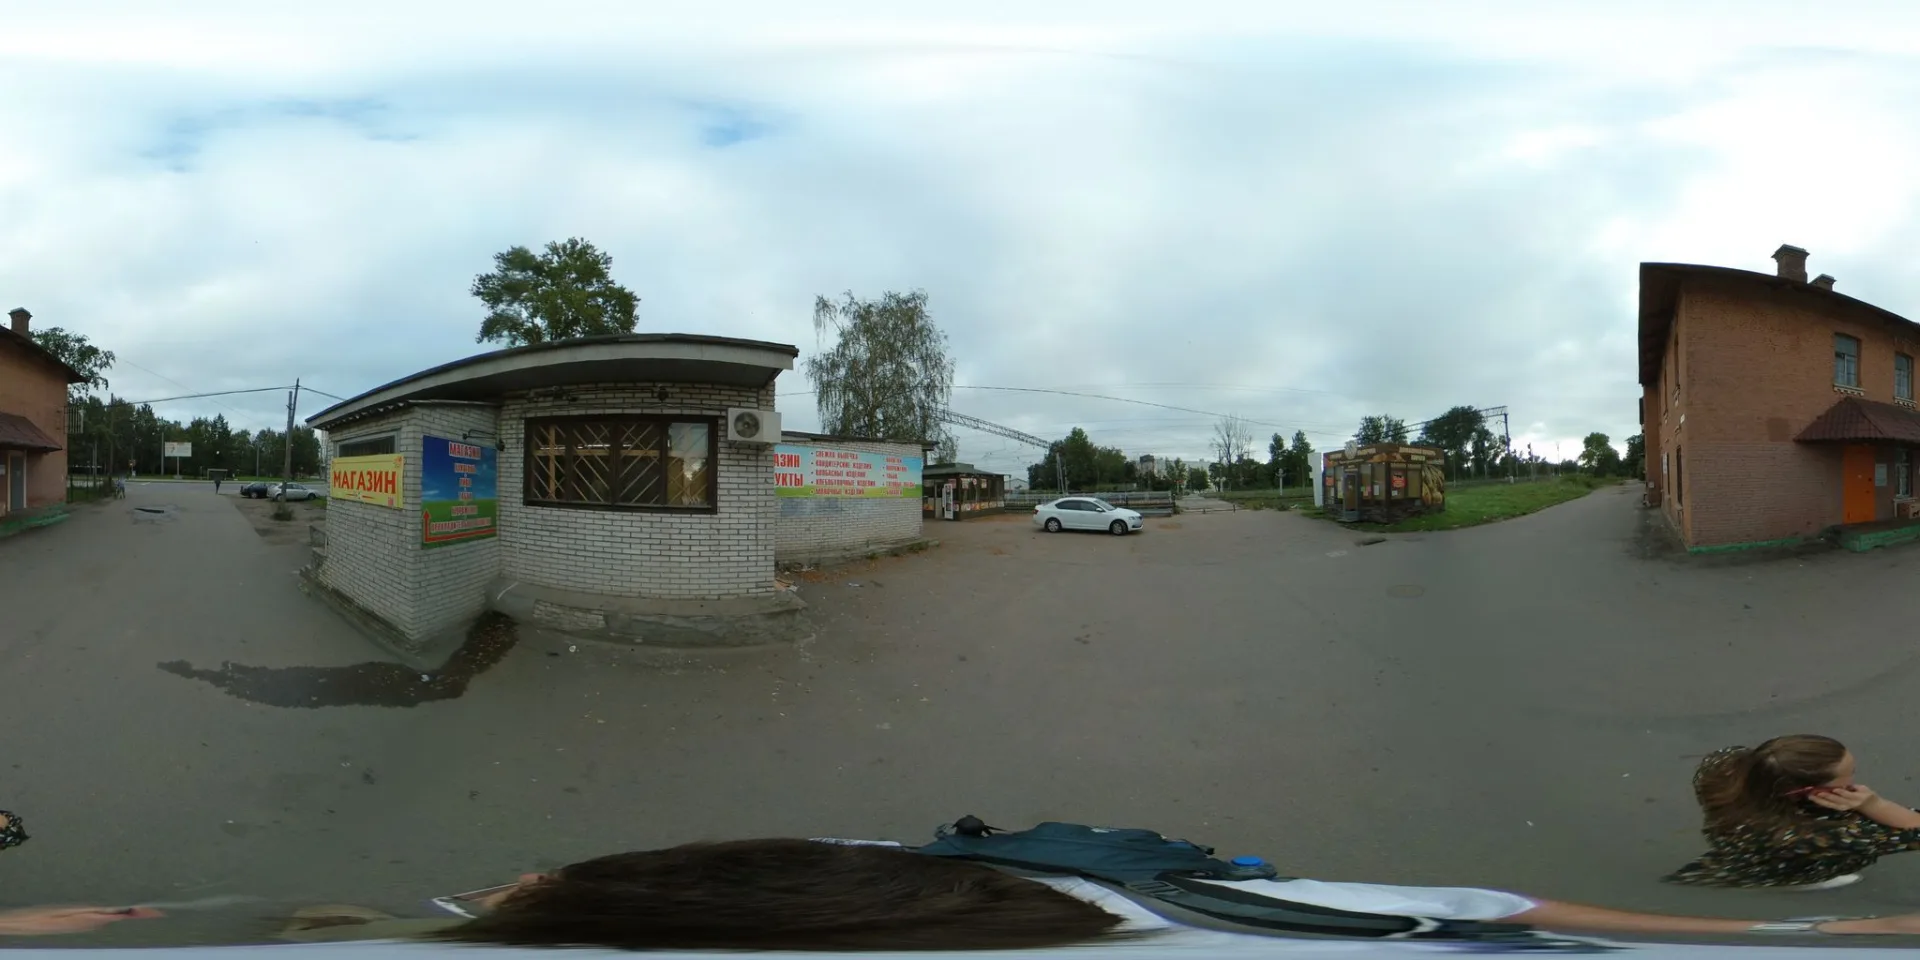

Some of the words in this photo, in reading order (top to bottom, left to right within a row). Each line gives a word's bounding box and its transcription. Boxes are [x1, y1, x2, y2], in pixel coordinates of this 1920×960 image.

[450, 442, 481, 459] МАГАЗИН
[333, 470, 397, 494] МАГАЗИН
[775, 473, 803, 487] УКТЫ
